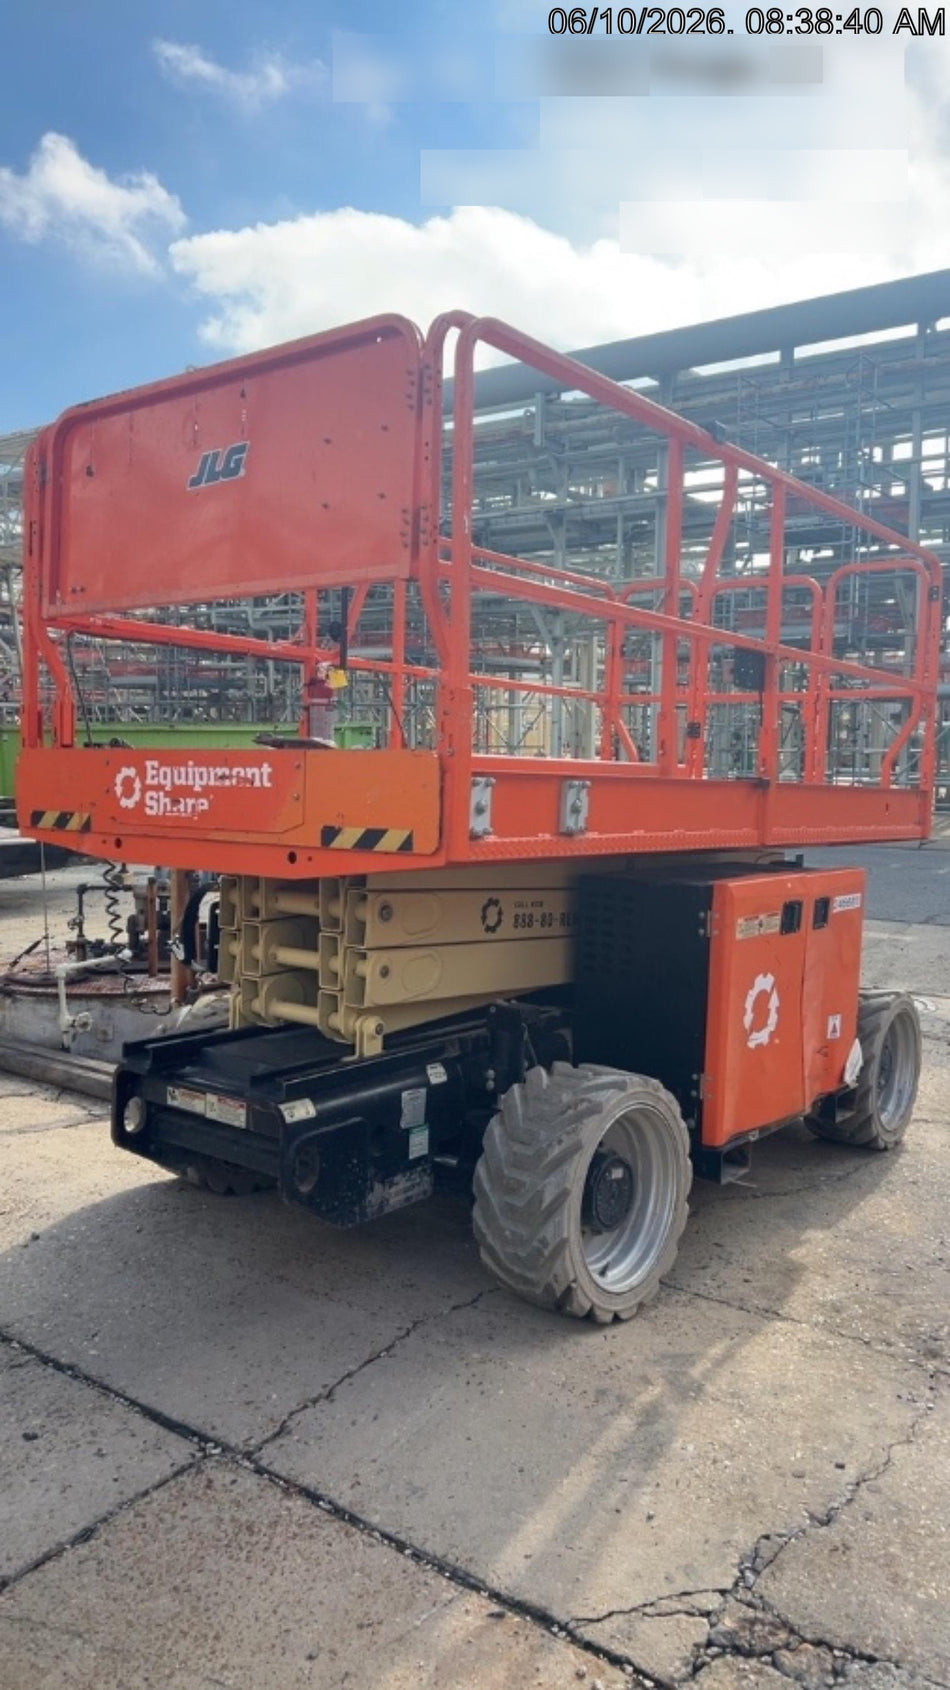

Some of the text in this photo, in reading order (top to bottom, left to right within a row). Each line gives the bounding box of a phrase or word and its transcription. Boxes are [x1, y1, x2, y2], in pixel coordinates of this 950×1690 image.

[187, 440, 249, 490] JLG
[145, 760, 272, 791] Equipment
[145, 791, 209, 818] Share
